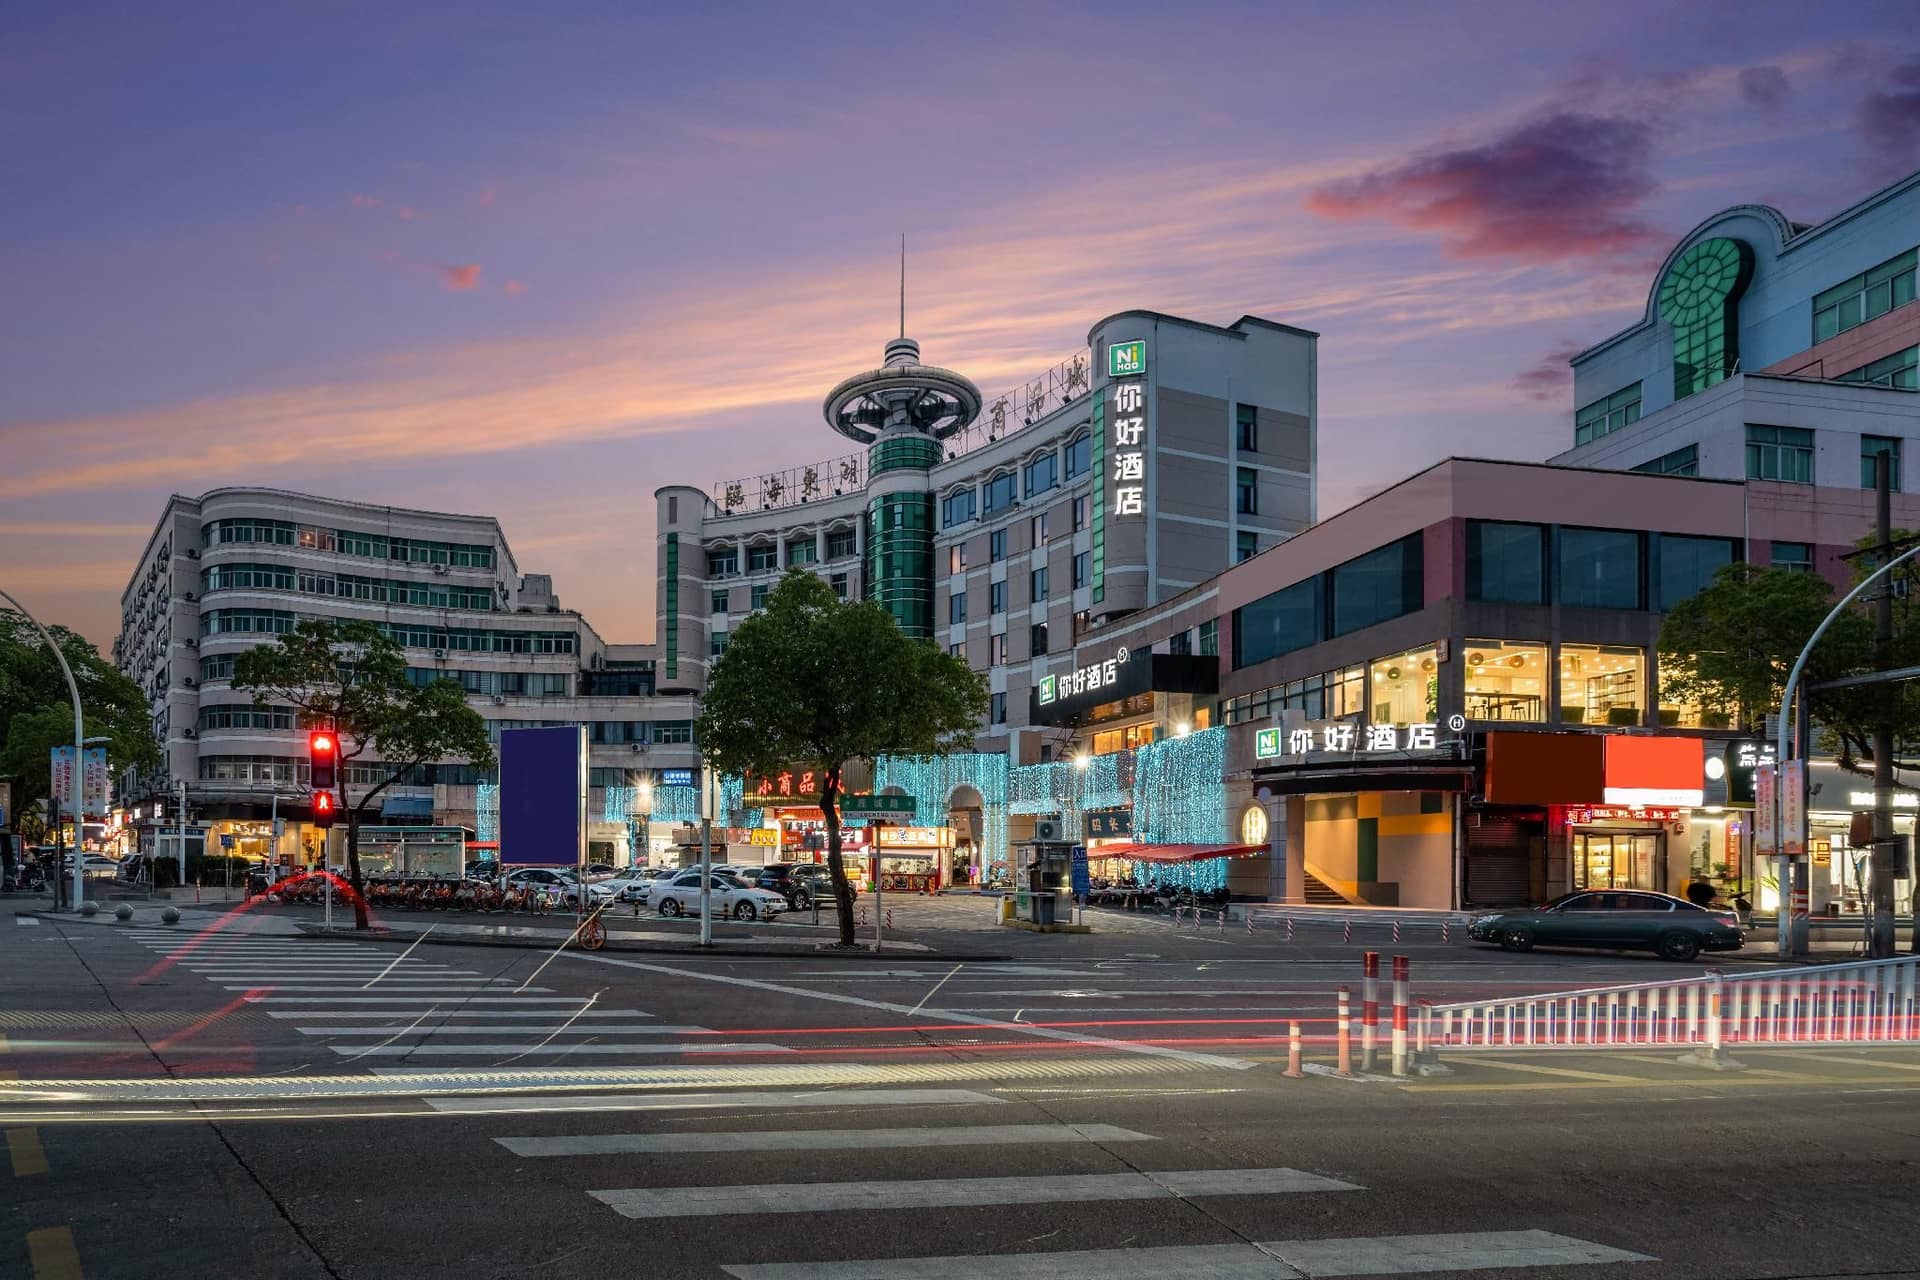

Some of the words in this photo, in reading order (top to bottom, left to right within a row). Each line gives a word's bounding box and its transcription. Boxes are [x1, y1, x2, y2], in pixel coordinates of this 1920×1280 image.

[1116, 345, 1138, 363] Ni
[1114, 383, 1144, 515] 你好酒店
[1058, 658, 1117, 700] 你好酒店
[1260, 731, 1276, 748] Ni
[1288, 723, 1437, 755] 你好酒店
